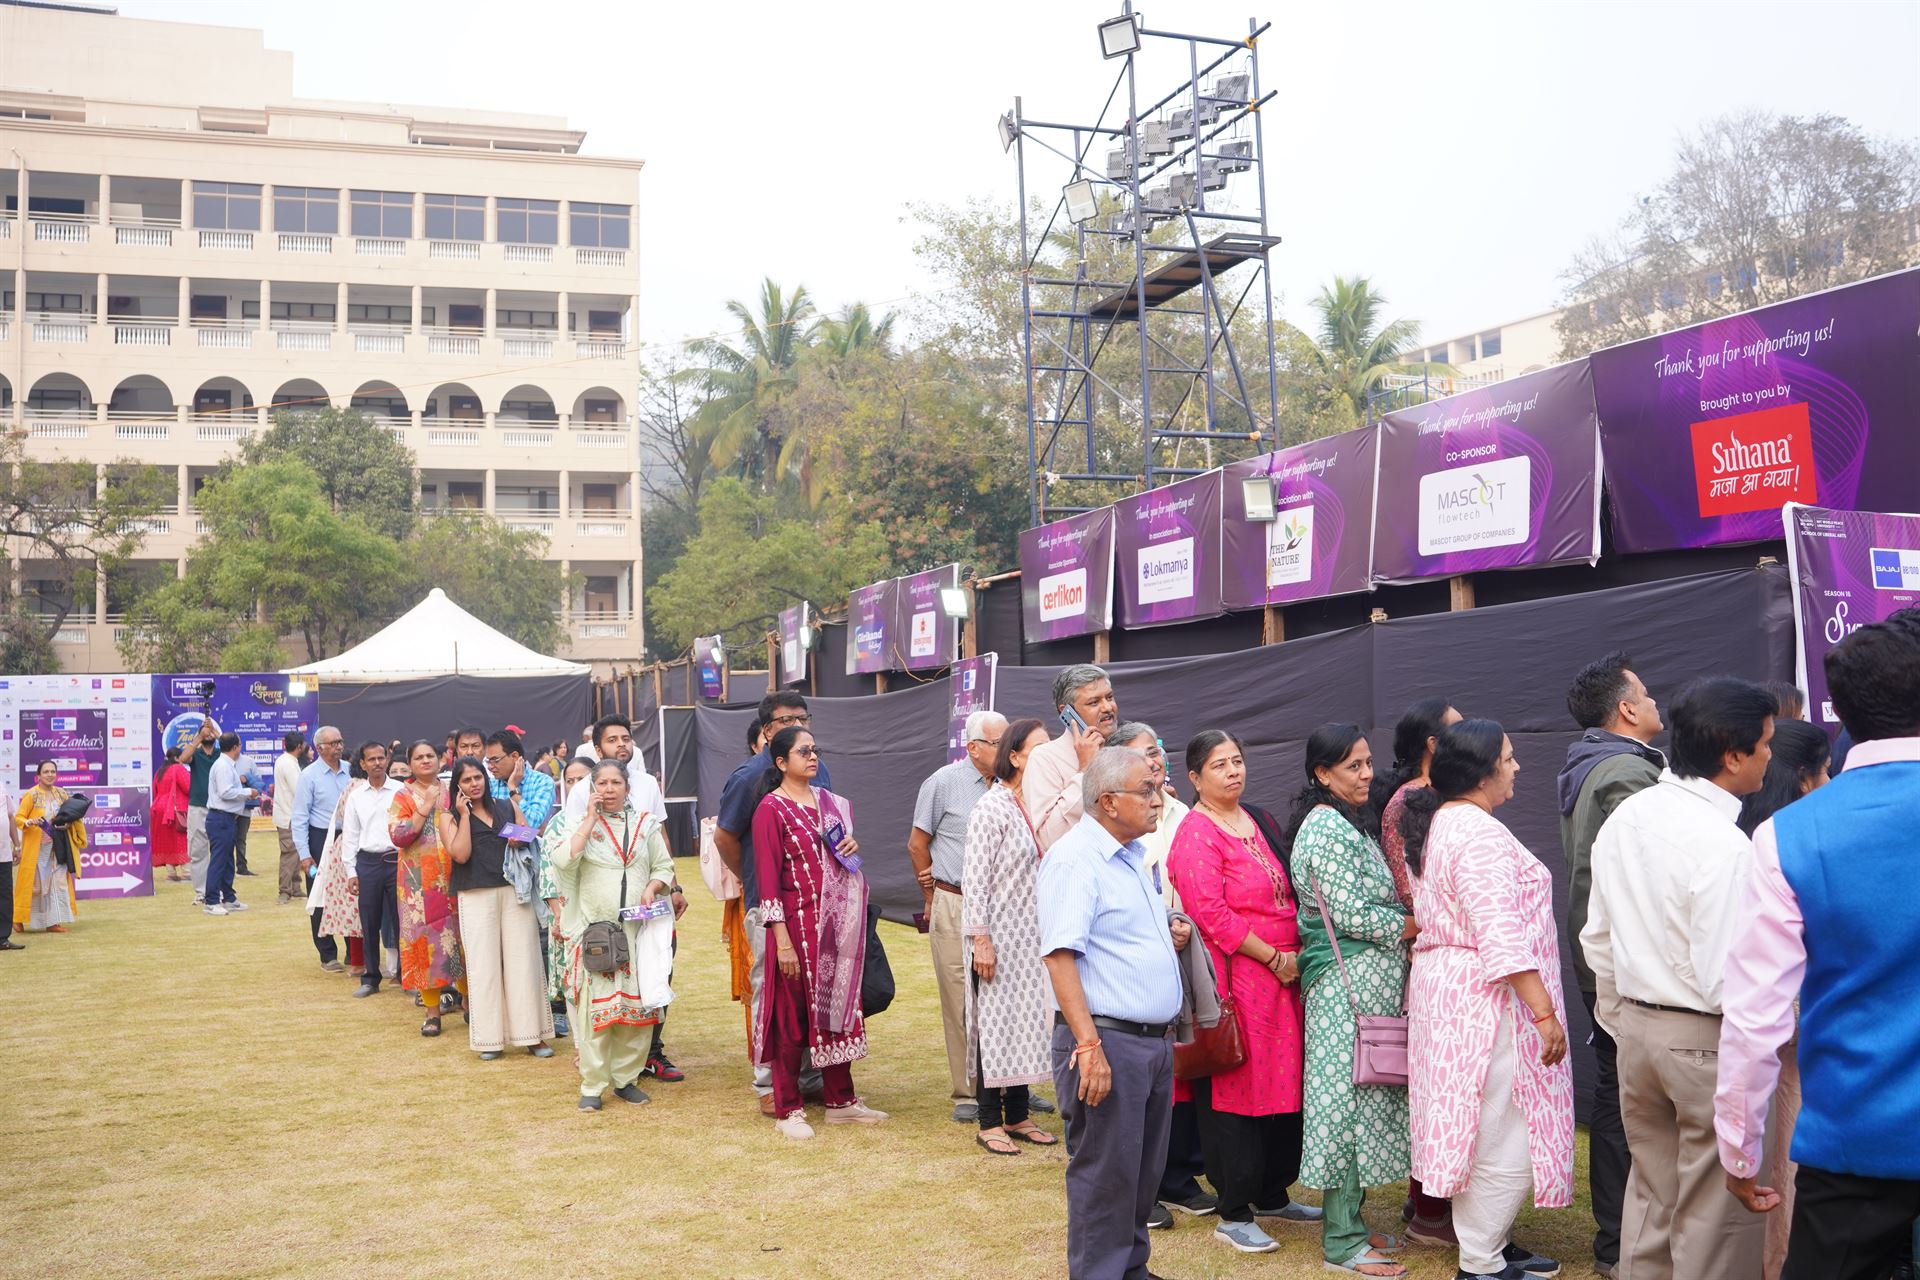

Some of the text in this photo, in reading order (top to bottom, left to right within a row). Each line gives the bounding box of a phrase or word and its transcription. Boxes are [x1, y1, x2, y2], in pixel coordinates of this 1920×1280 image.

[1655, 318, 1834, 380] Thank you for supporting us!
[1700, 384, 1791, 411] Brought to you by
[1418, 392, 1539, 438] Thank you for supporting us!
[1446, 443, 1497, 462] CO-SPONSOR
[1712, 430, 1792, 474] Suhana
[1281, 462, 1292, 483] for
[1291, 456, 1326, 482] supporting
[1326, 451, 1338, 470] us!
[1741, 473, 1762, 495] आ
[1302, 490, 1314, 501] with
[1438, 481, 1506, 511] MASCOT
[1136, 504, 1150, 520] Thank
[1149, 509, 1158, 524] you
[1157, 500, 1165, 518] for
[1165, 498, 1188, 518] supporting
[1438, 510, 1481, 525] flowtech
[1429, 527, 1516, 547] MASCOT GROUP OF COMPANIES
[1271, 544, 1286, 555] THE
[1150, 558, 1188, 577] Lokmanya
[1271, 553, 1300, 568] NATURE
[1875, 565, 1900, 573] BAJAJ
[80, 851, 140, 868] COUCH
